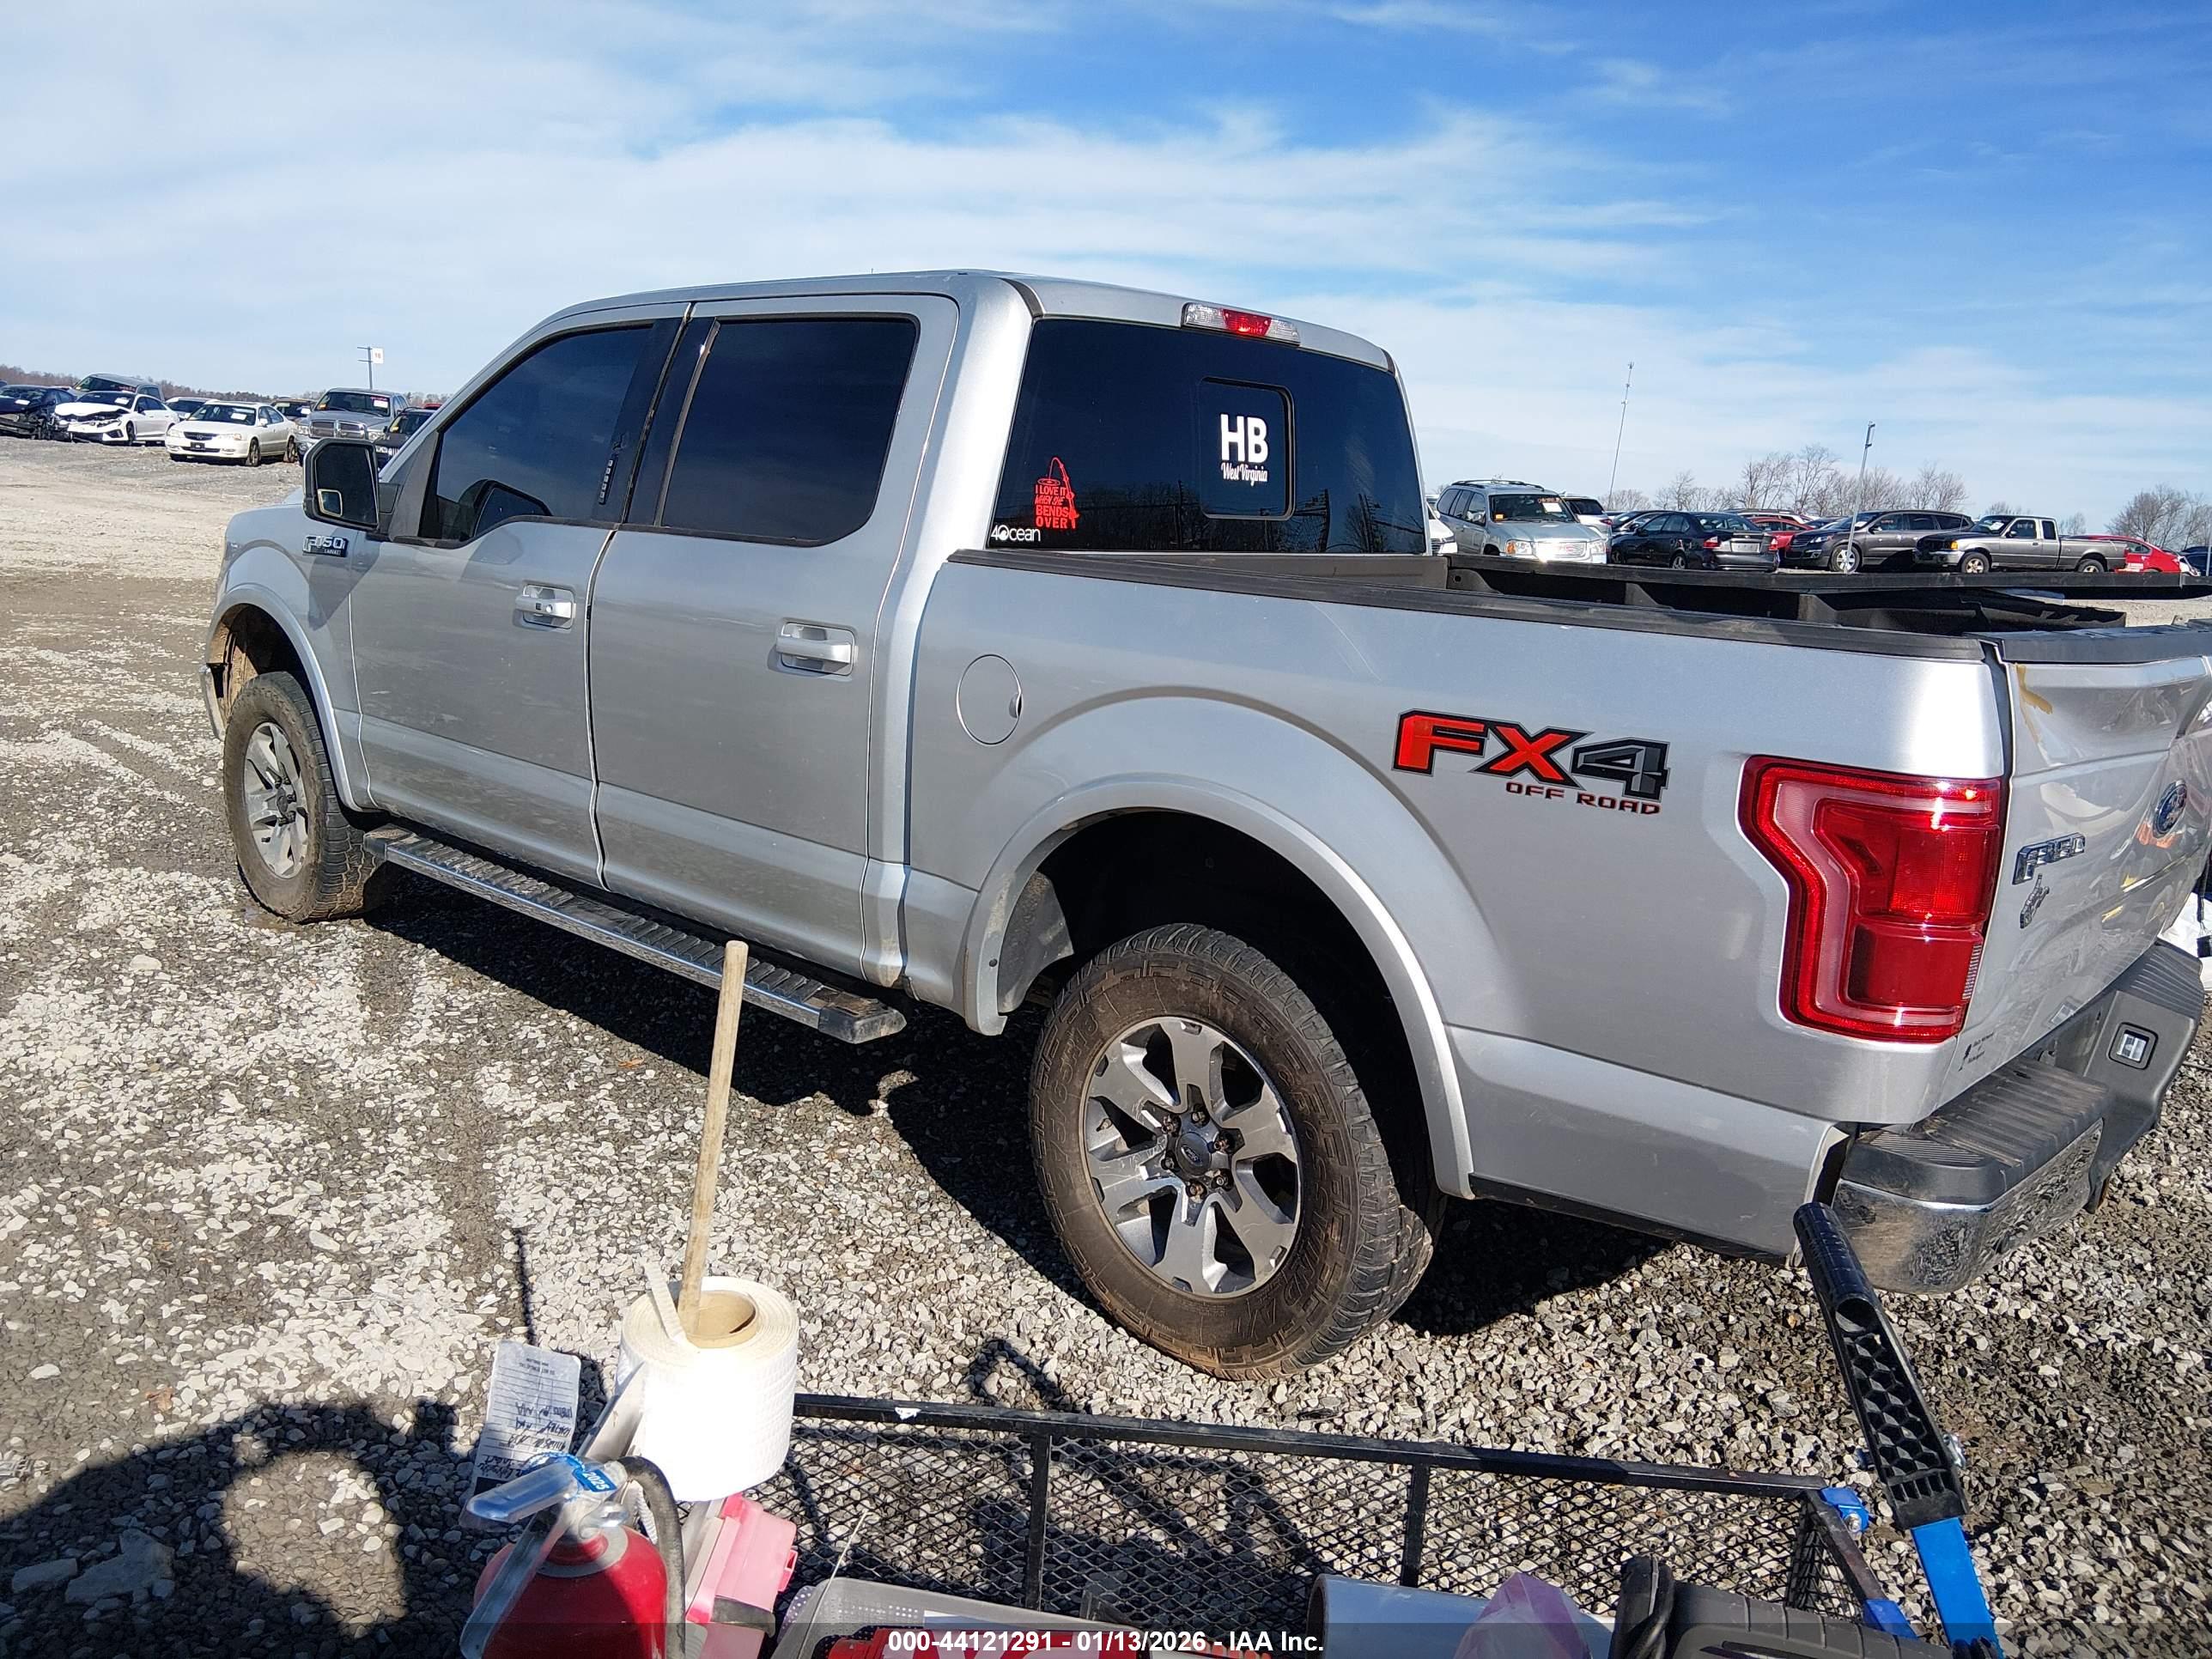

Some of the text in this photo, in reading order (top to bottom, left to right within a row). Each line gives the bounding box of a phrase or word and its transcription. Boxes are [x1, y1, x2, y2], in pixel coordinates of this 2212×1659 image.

[1220, 414, 1268, 464] HB
[1220, 462, 1268, 487] West Virginia
[1039, 485, 1060, 495] LOVE
[1060, 486, 1067, 496] IT
[1034, 495, 1051, 505] WHEN
[1036, 505, 1069, 517] BENDS
[1036, 516, 1068, 528] OVER
[1391, 708, 1671, 802] FX4
[1505, 781, 1662, 816] OFF ROAD
[582, 1472, 611, 1490] 2025
